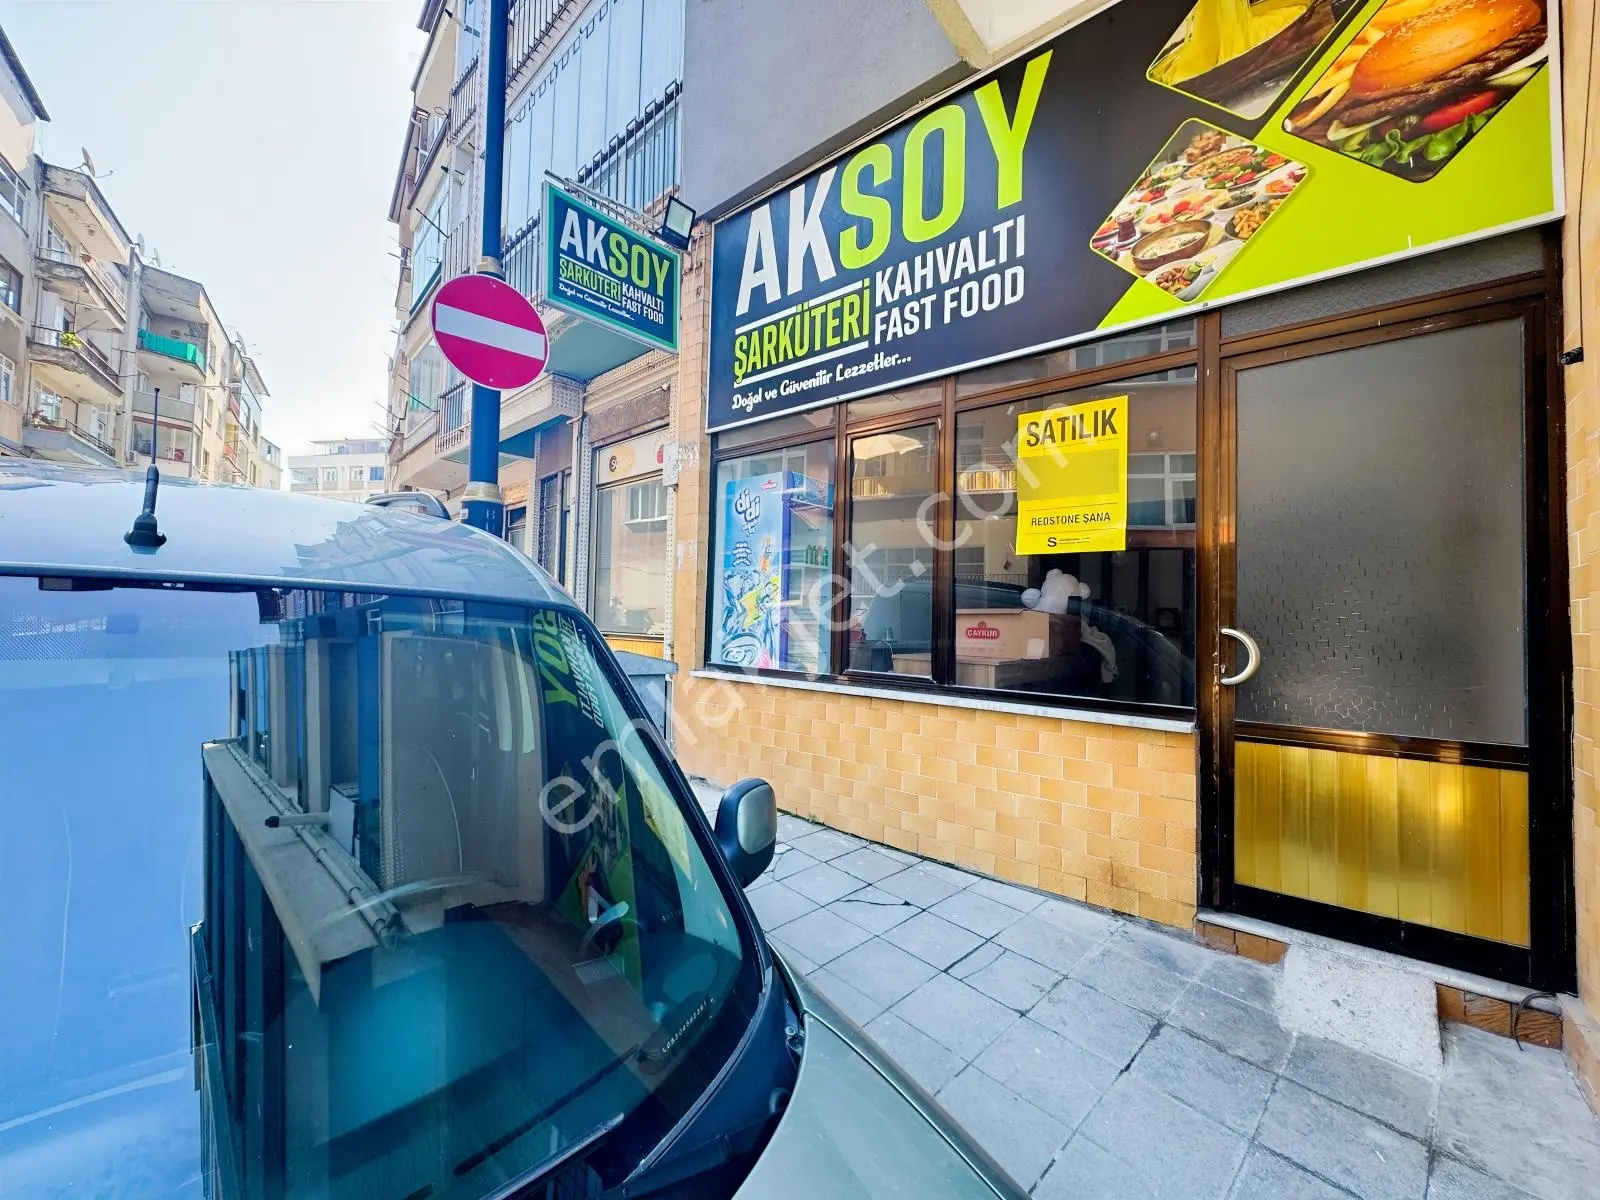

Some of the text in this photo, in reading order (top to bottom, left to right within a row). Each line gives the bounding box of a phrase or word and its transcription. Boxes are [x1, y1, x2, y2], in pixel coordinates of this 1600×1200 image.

[735, 49, 1054, 317] AKSOY
[559, 207, 671, 297] AKSOY
[875, 214, 1026, 308] KAHVALTI
[621, 296, 664, 325] FAST FOOD
[622, 281, 664, 313] KAHVALTI
[873, 264, 1026, 346] FAST FOOD
[733, 277, 871, 385] ŞARKÜTERİ
[731, 387, 763, 413] Doğal
[764, 387, 778, 401] ve
[779, 368, 833, 397] Güvenilir
[1026, 407, 1118, 447] SATILIK
[1031, 511, 1111, 527] REDSTONE ŞANA
